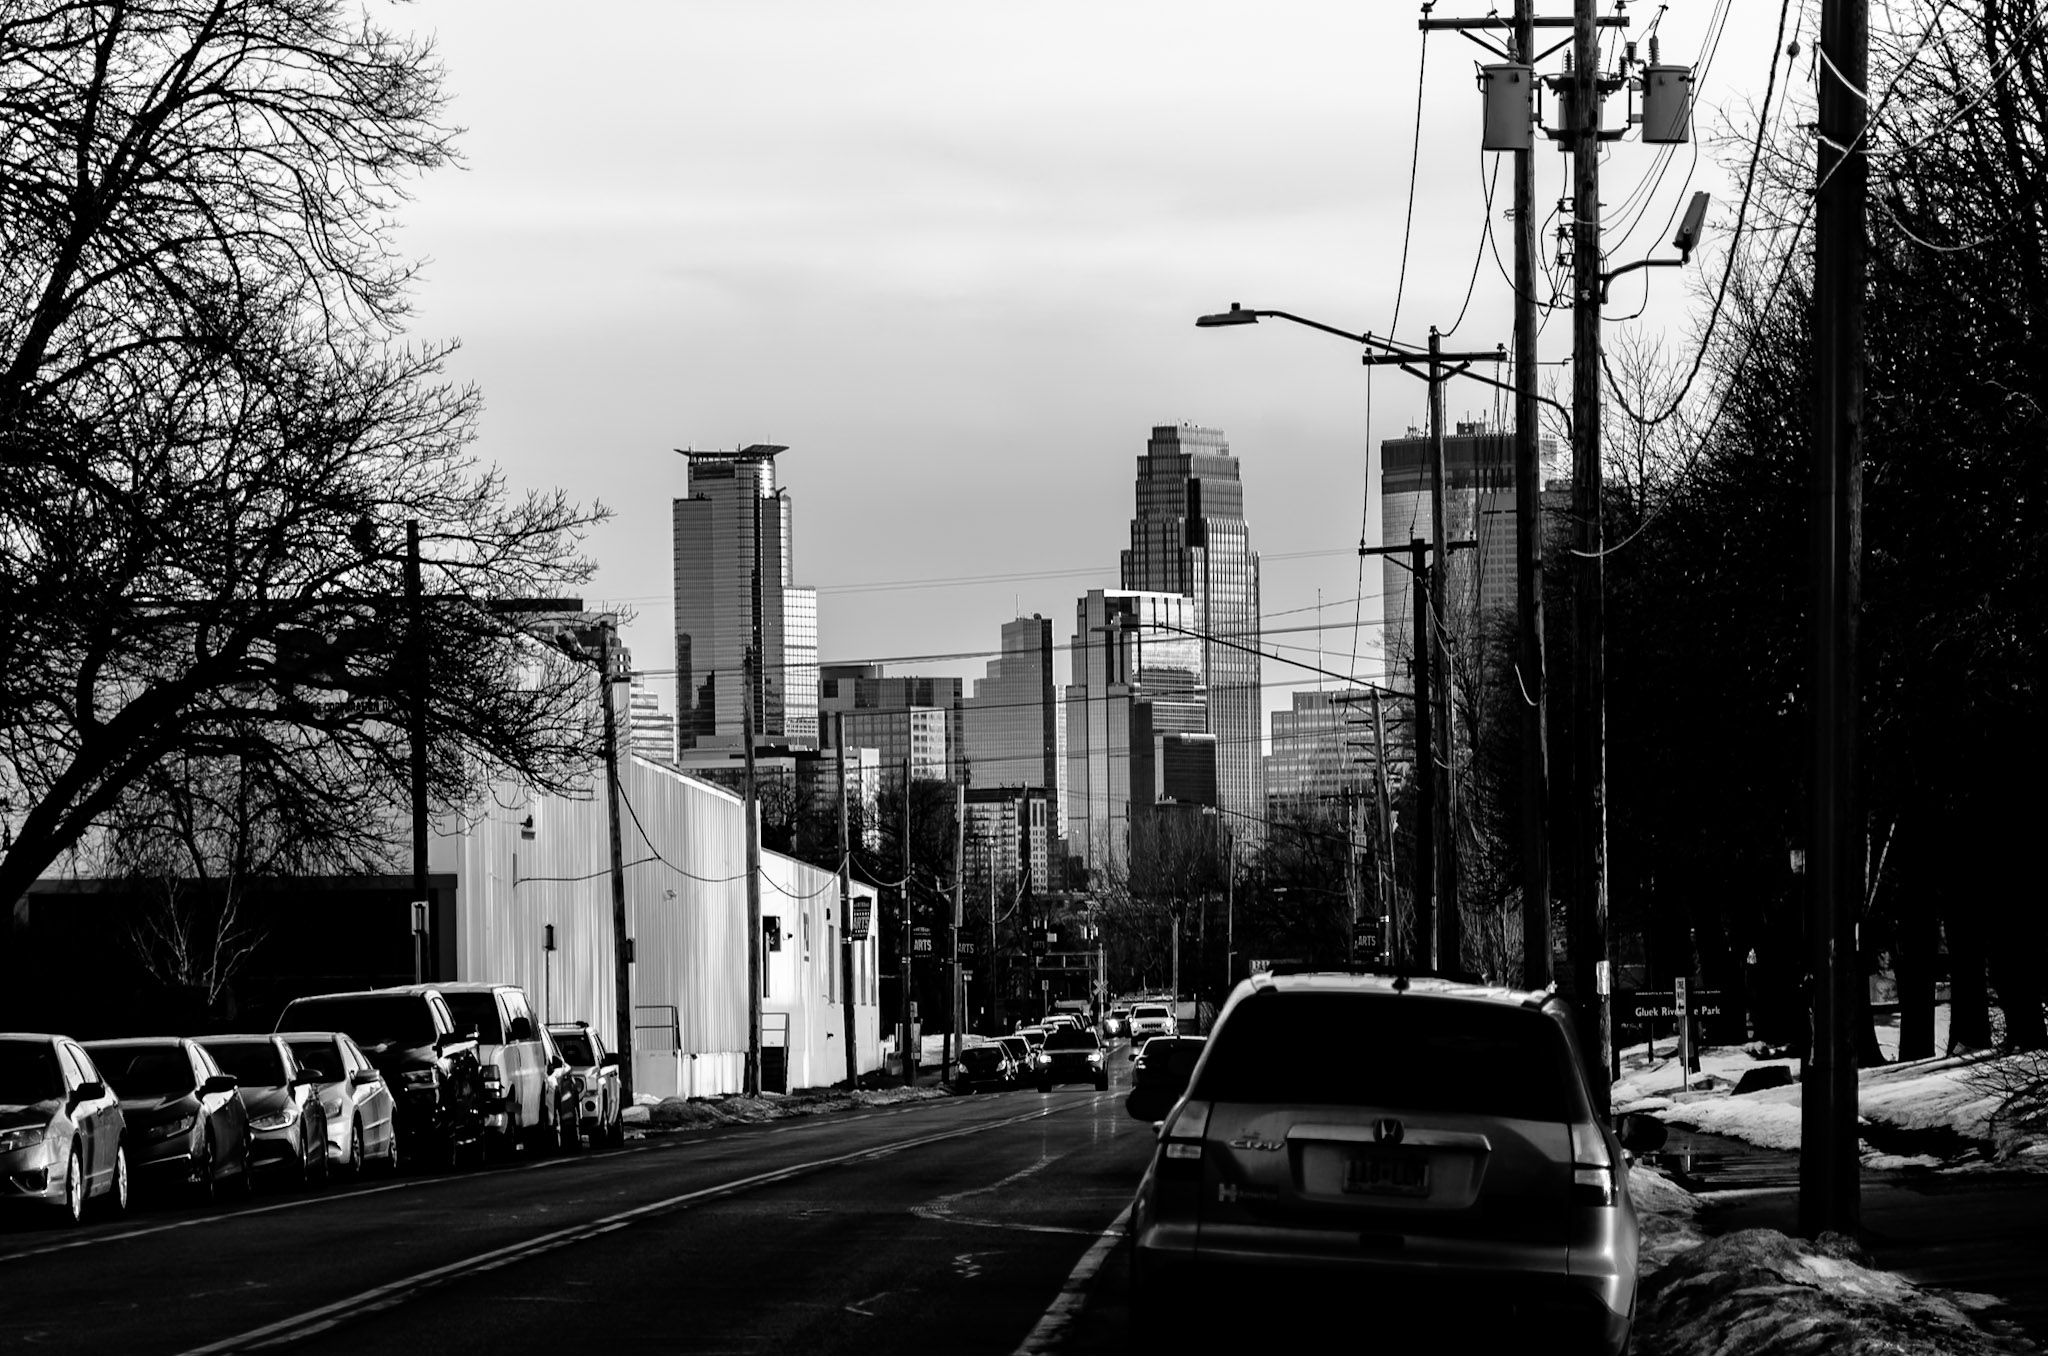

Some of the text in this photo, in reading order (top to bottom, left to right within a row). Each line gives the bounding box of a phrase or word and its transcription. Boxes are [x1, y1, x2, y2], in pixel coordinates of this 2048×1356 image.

[854, 917, 869, 930] ARTS
[914, 939, 932, 951] ARTS
[1358, 935, 1377, 947] ARTS
[958, 943, 975, 954] ARTS
[1635, 1007, 1658, 1017] Gluek
[1701, 1005, 1721, 1015] Park
